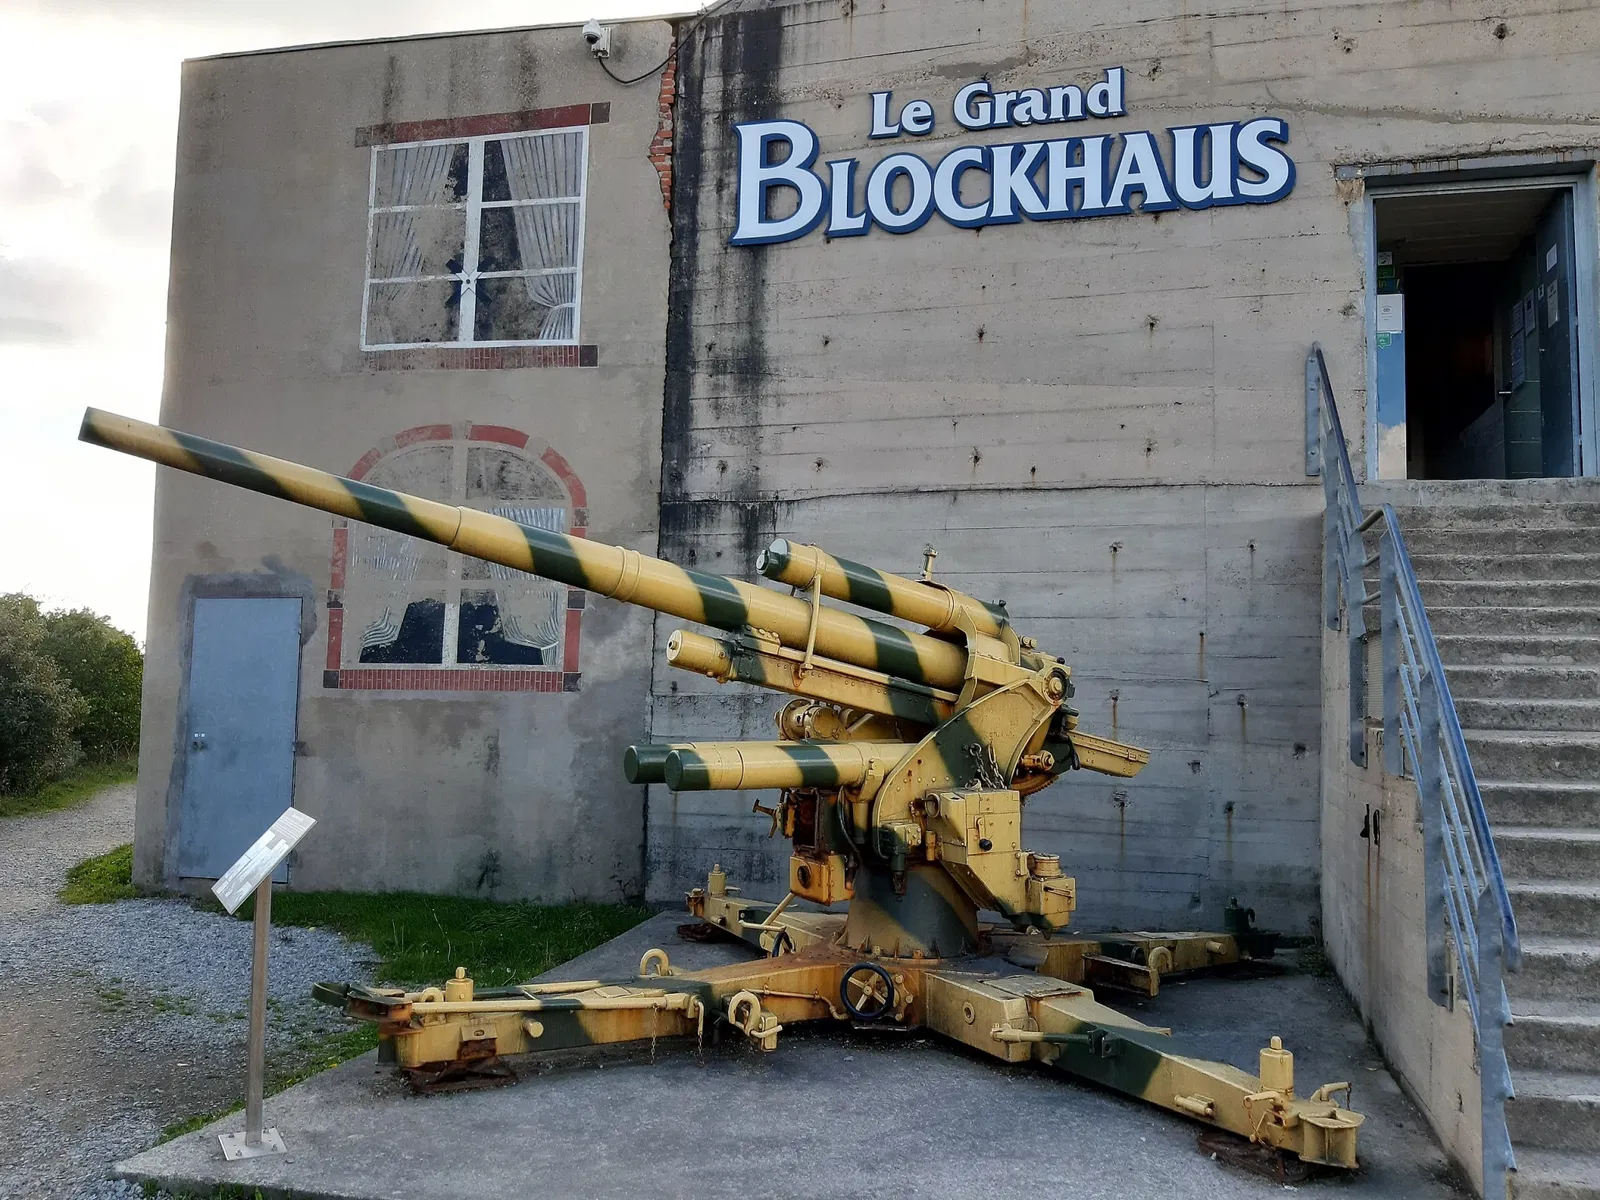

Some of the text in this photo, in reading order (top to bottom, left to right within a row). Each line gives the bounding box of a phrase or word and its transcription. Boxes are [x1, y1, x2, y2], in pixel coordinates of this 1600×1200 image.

[869, 66, 1129, 139] Le Grand
[730, 117, 1296, 247] BLOCKHAUS
